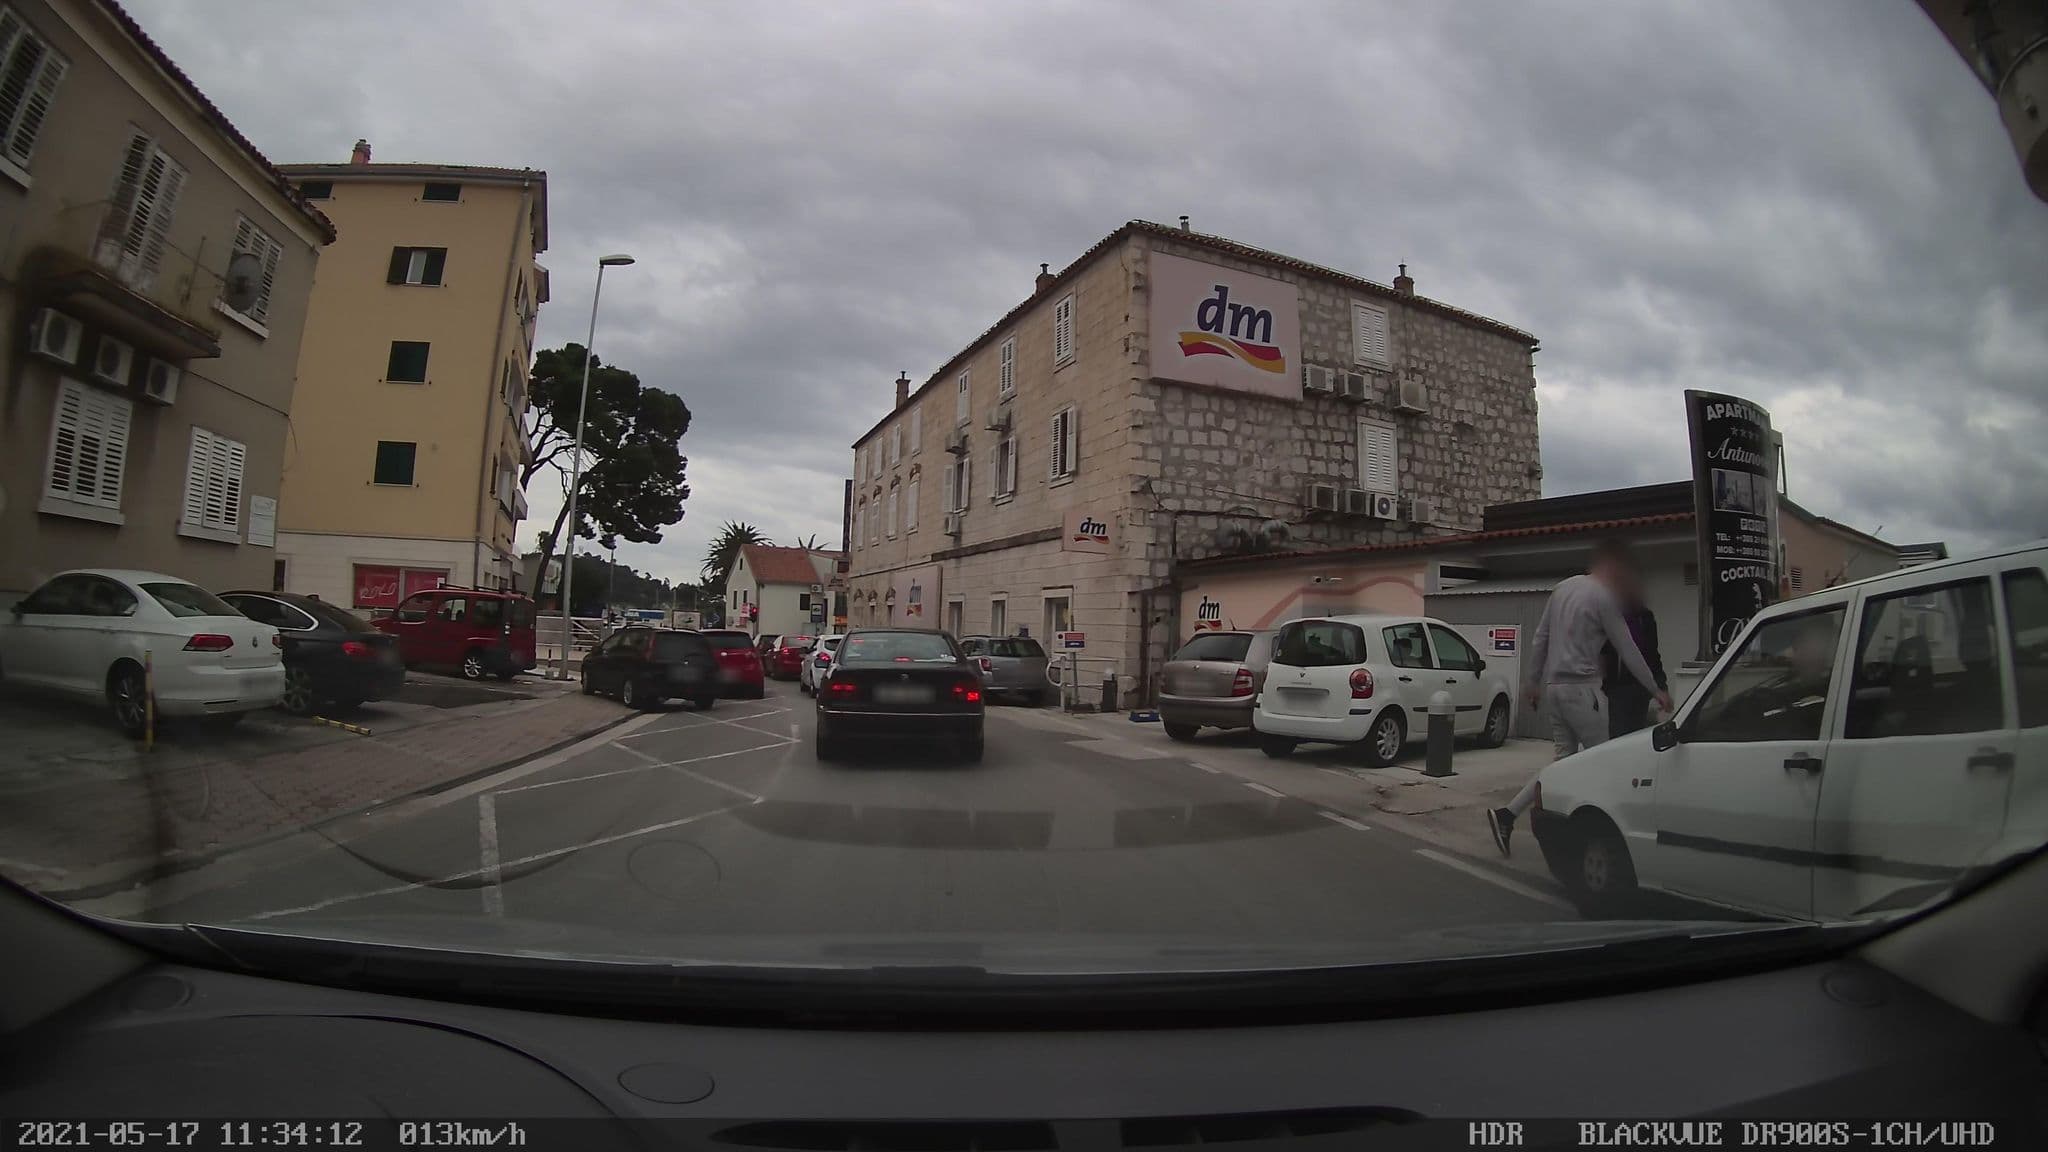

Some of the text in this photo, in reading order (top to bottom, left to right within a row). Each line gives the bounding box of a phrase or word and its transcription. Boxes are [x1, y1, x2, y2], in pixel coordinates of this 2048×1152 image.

[1197, 284, 1273, 343] dm
[1706, 403, 1762, 426] APARTM
[1707, 437, 1763, 466] Antuno
[1080, 517, 1107, 535] dm
[1198, 596, 1220, 619] dm
